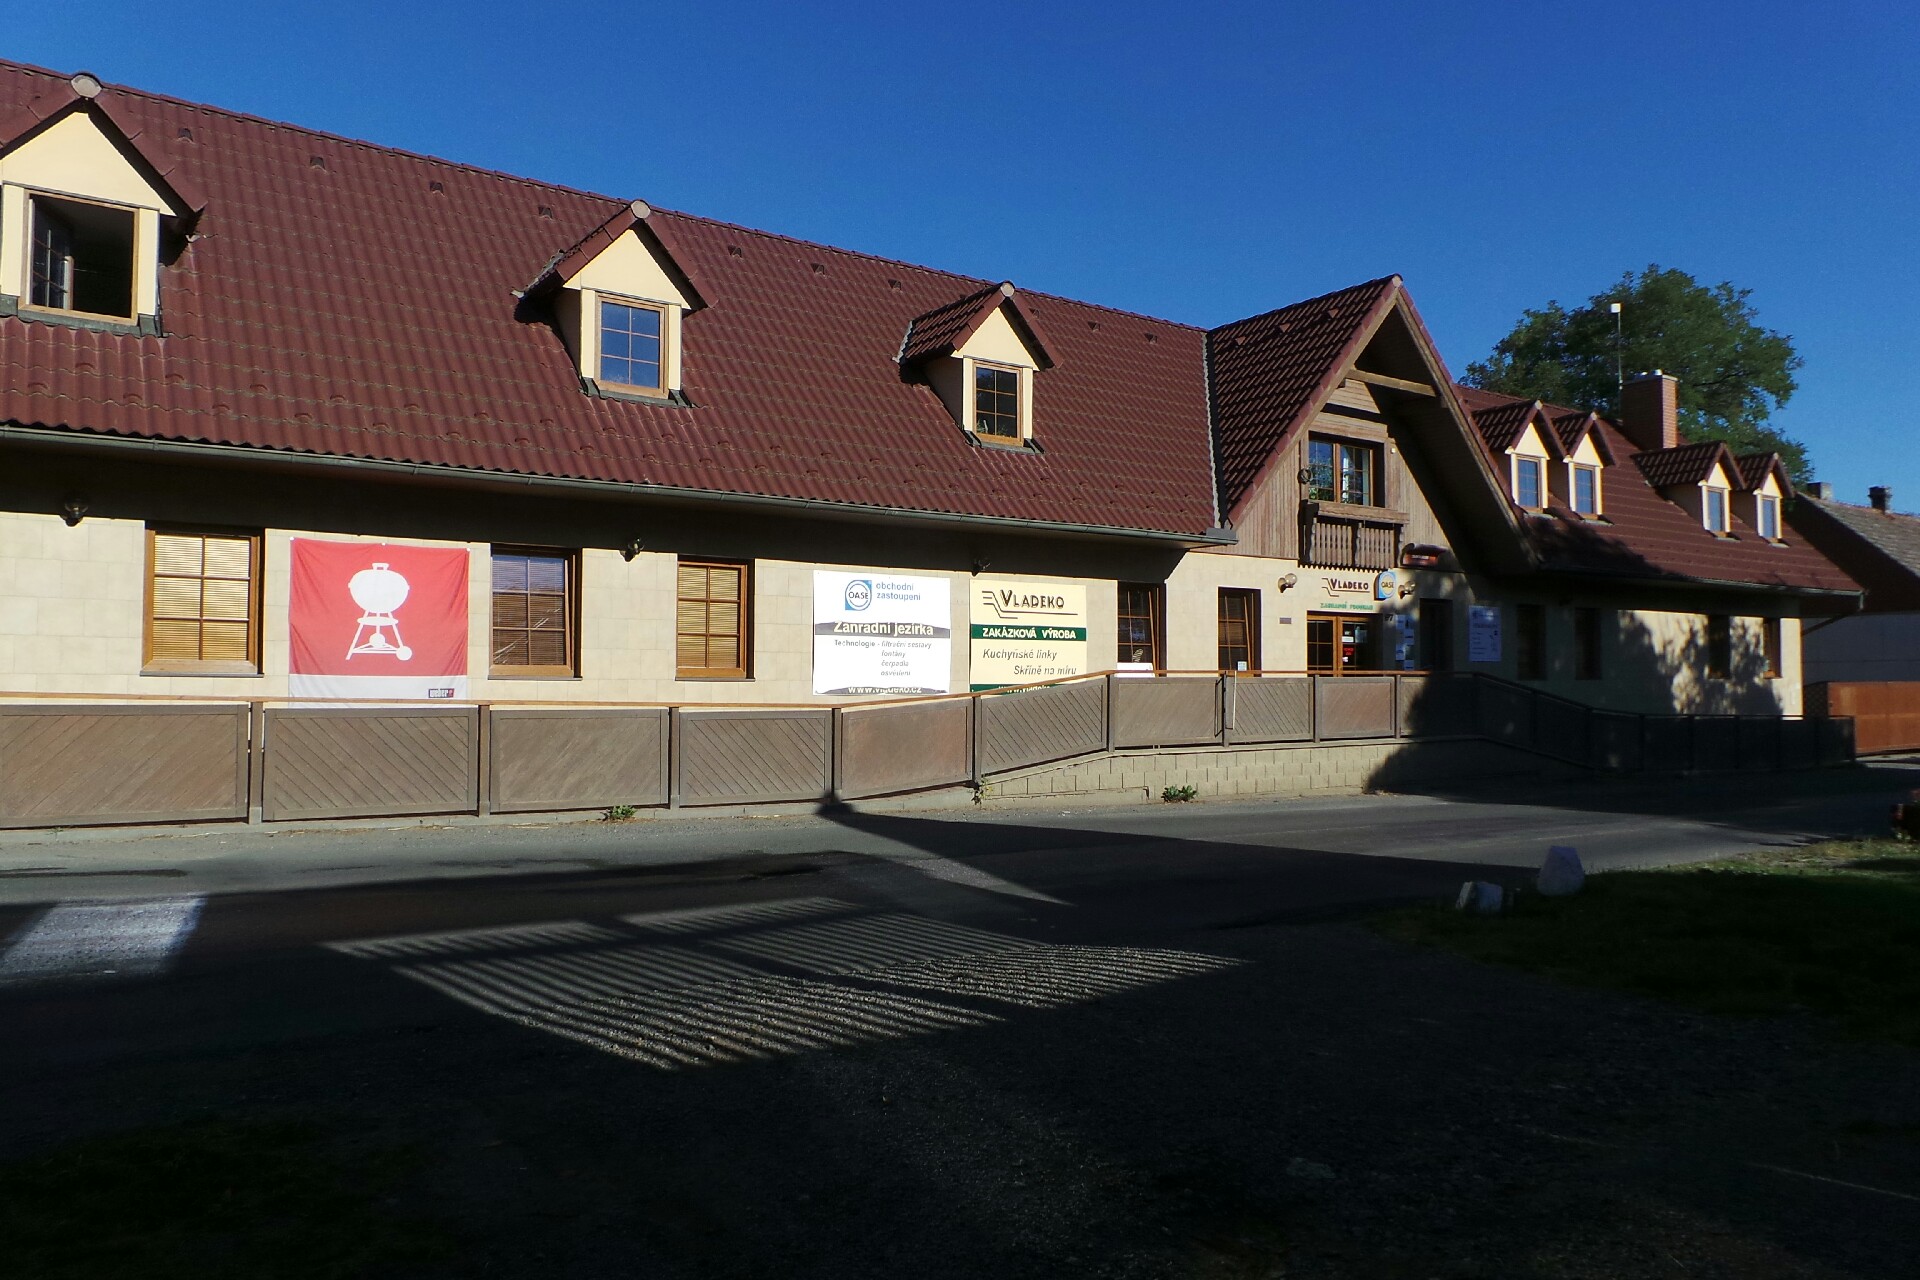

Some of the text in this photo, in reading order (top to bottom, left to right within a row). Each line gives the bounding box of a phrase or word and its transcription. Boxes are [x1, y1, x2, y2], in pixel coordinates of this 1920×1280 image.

[1381, 581, 1394, 589] OASE
[848, 591, 868, 599] OASE
[893, 621, 934, 637] jezírka
[982, 626, 1076, 639] ZAKÁZKOVÁ VÝROBA
[835, 639, 876, 649] Technologie
[983, 648, 1058, 661] Kuchyňské linky
[881, 660, 909, 668] čerpadla
[1014, 664, 1042, 675] Skříně
[1057, 665, 1077, 675] míru
